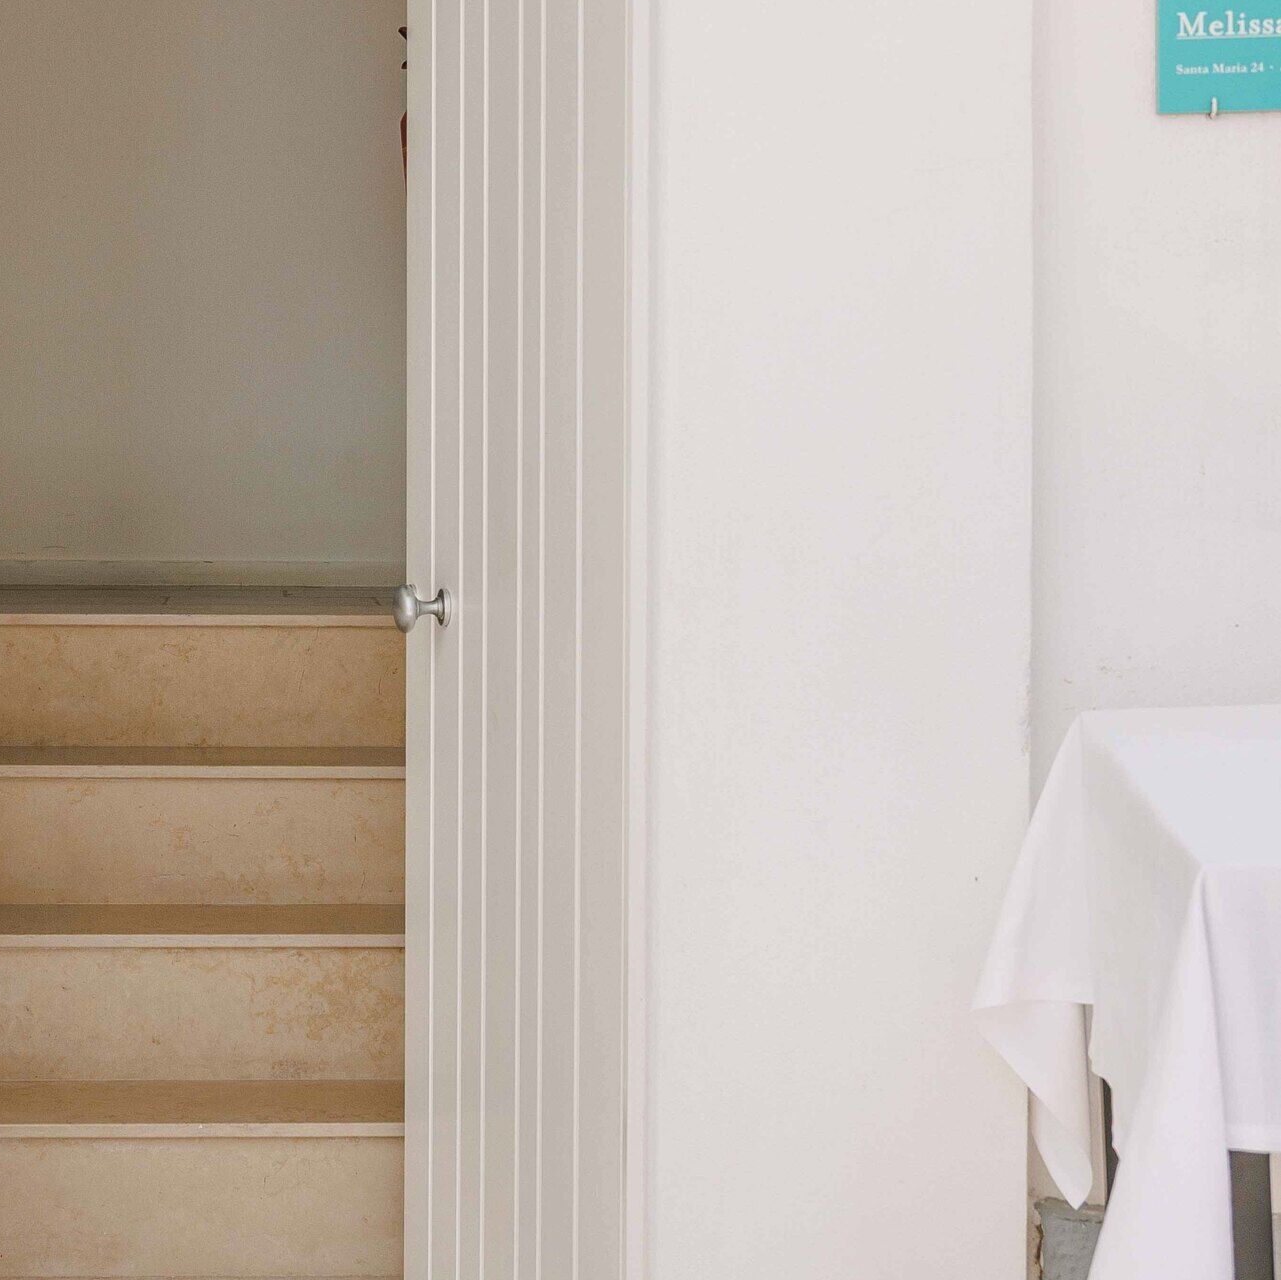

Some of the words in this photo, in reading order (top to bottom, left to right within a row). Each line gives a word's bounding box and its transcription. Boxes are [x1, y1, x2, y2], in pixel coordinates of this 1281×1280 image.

[1175, 63, 1210, 76] Santa
[1212, 63, 1248, 74] Maria
[1251, 62, 1265, 73] 24
